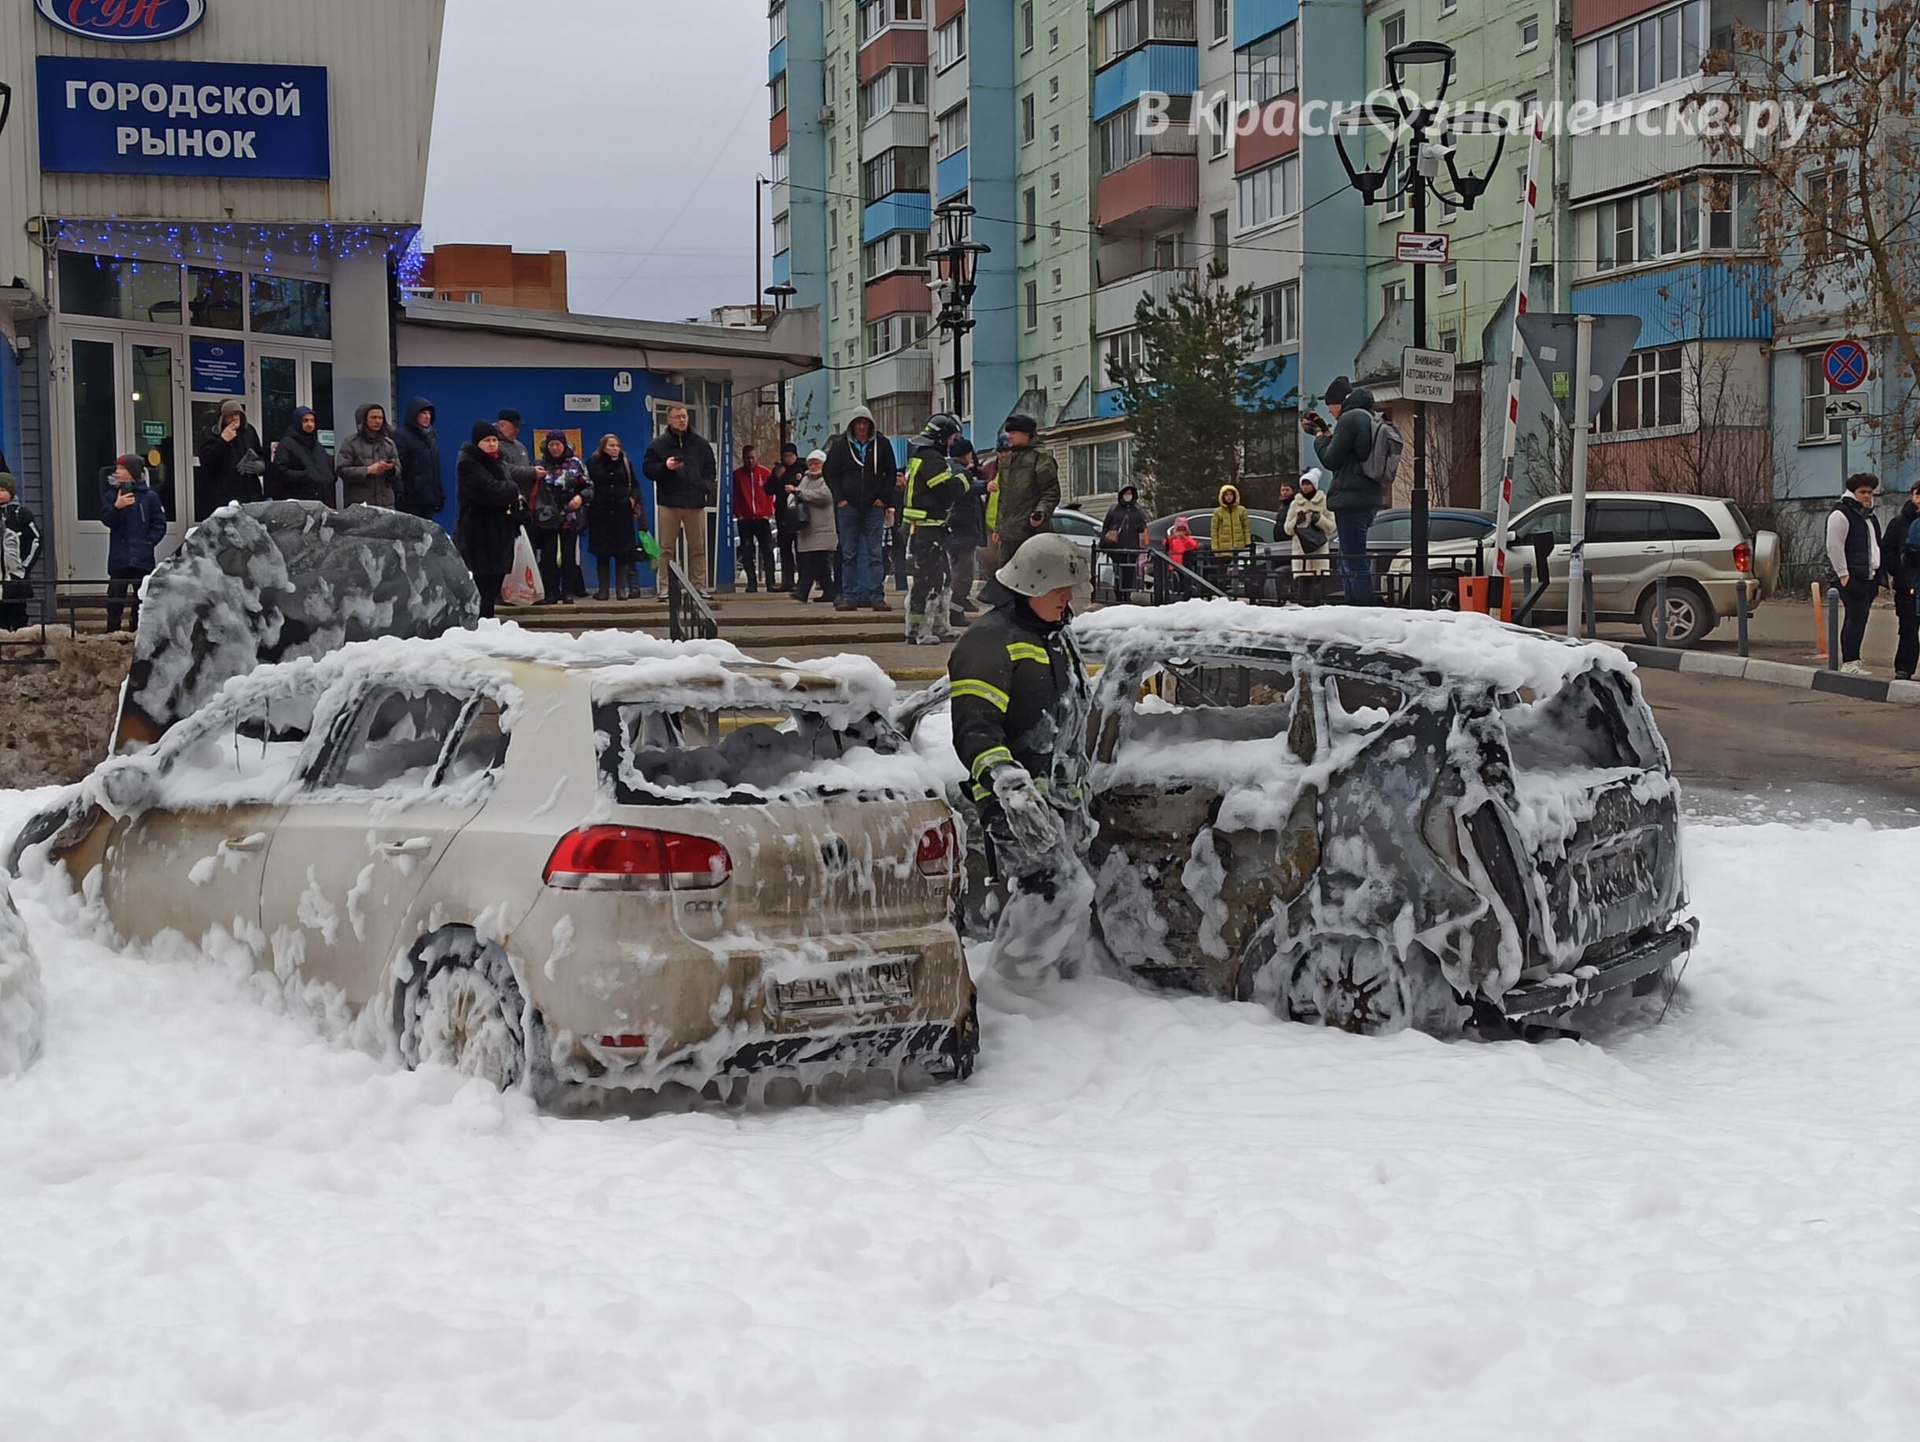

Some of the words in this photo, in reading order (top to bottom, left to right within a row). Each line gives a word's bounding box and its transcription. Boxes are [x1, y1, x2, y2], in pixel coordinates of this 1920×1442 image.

[65, 80, 302, 119] ГОРОДСКОЙ
[116, 126, 257, 159] РЫНОК
[616, 374, 630, 387] 14
[1414, 384, 1443, 396] ШЛАГБАУМ
